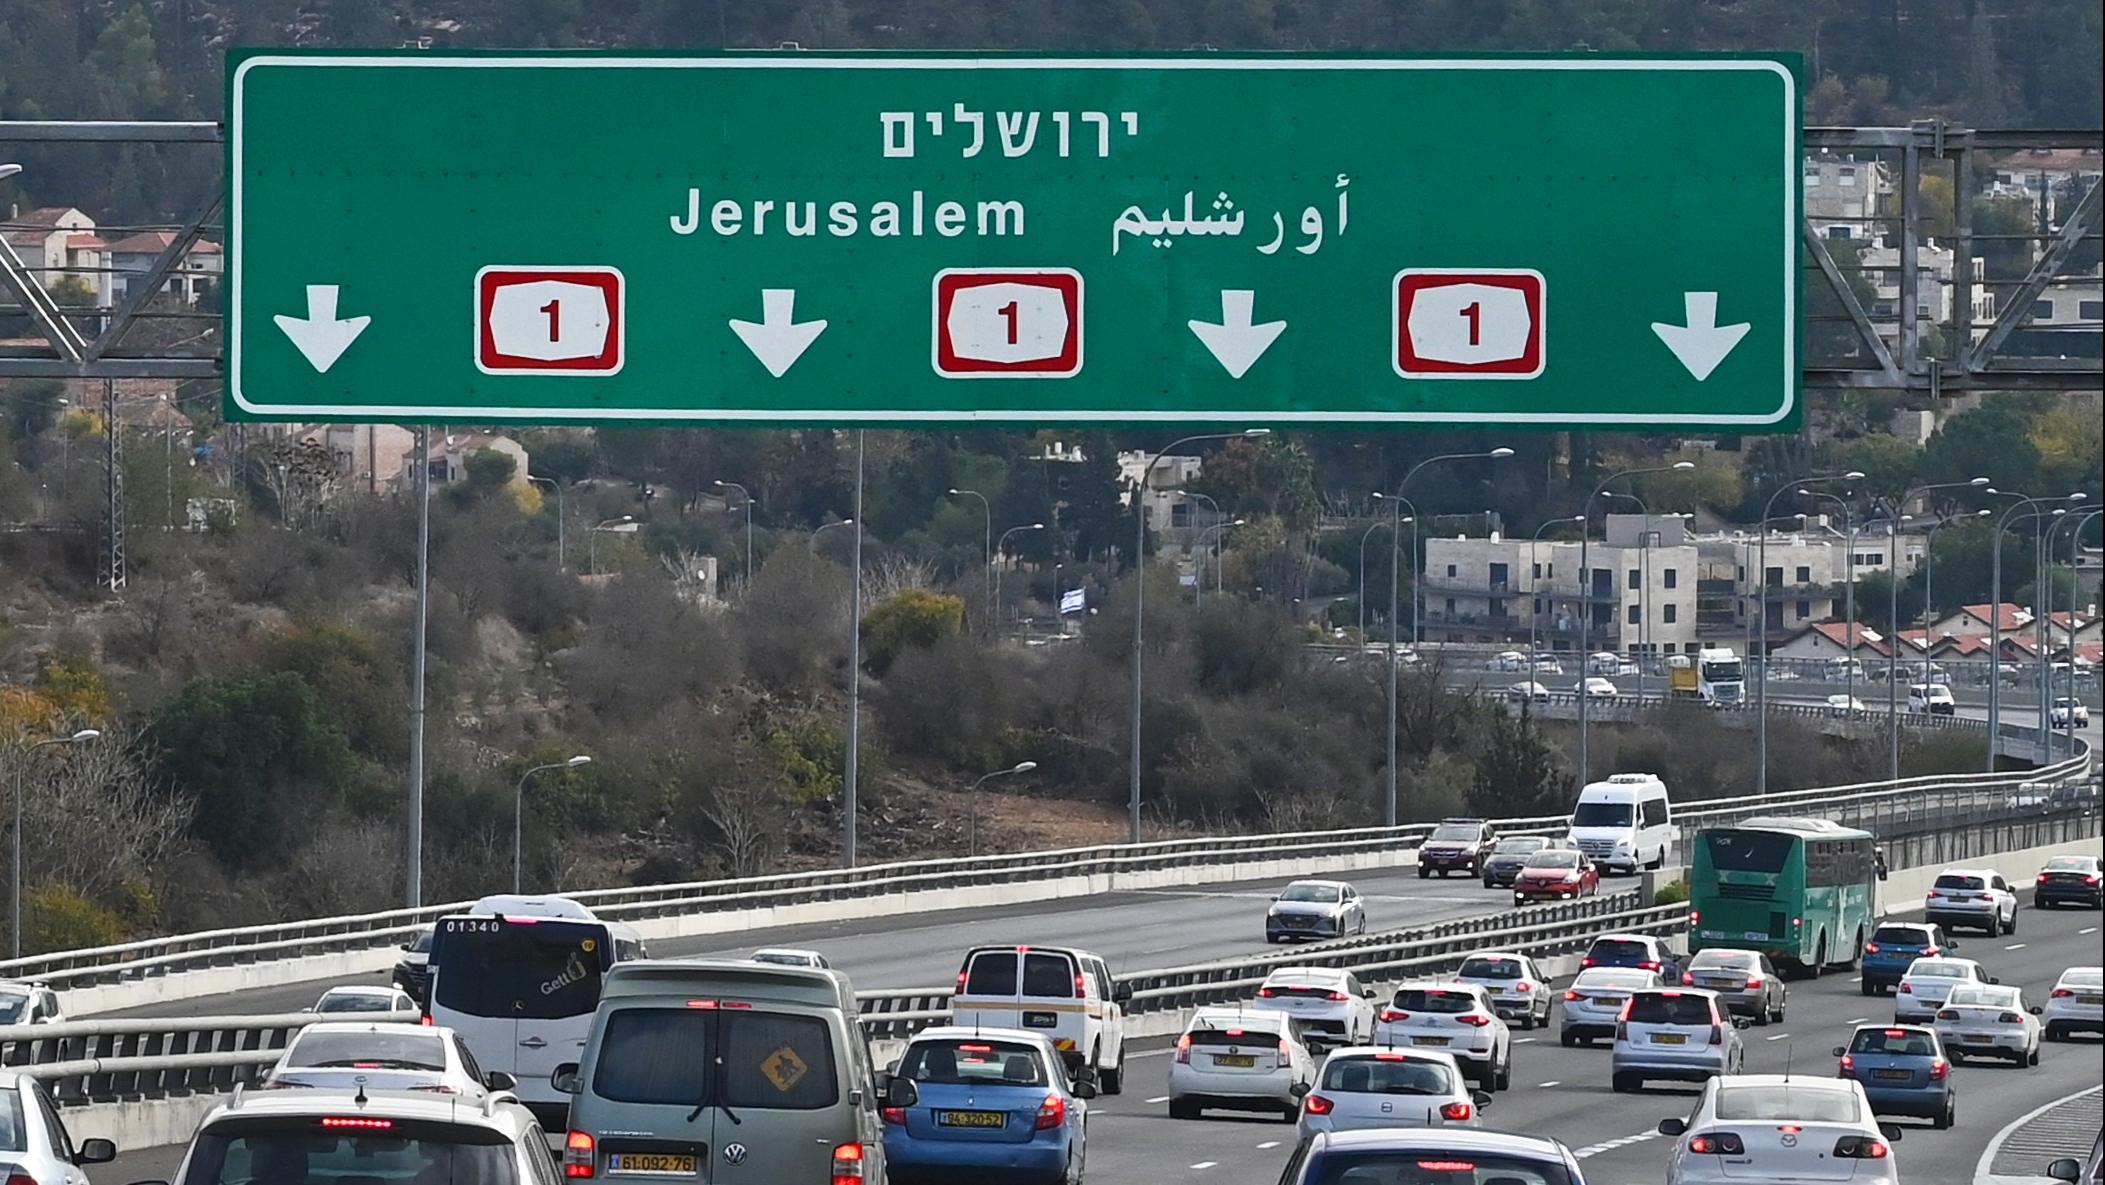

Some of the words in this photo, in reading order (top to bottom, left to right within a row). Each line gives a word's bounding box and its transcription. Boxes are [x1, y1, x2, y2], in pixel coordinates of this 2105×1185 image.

[880, 102, 1139, 158] ירושלים
[670, 188, 1025, 238] Jerusalem
[1112, 173, 1350, 256] أورشليم
[540, 299, 560, 343] 1
[997, 301, 1018, 345] 1
[1459, 301, 1480, 346] 1
[446, 920, 500, 933] 01340
